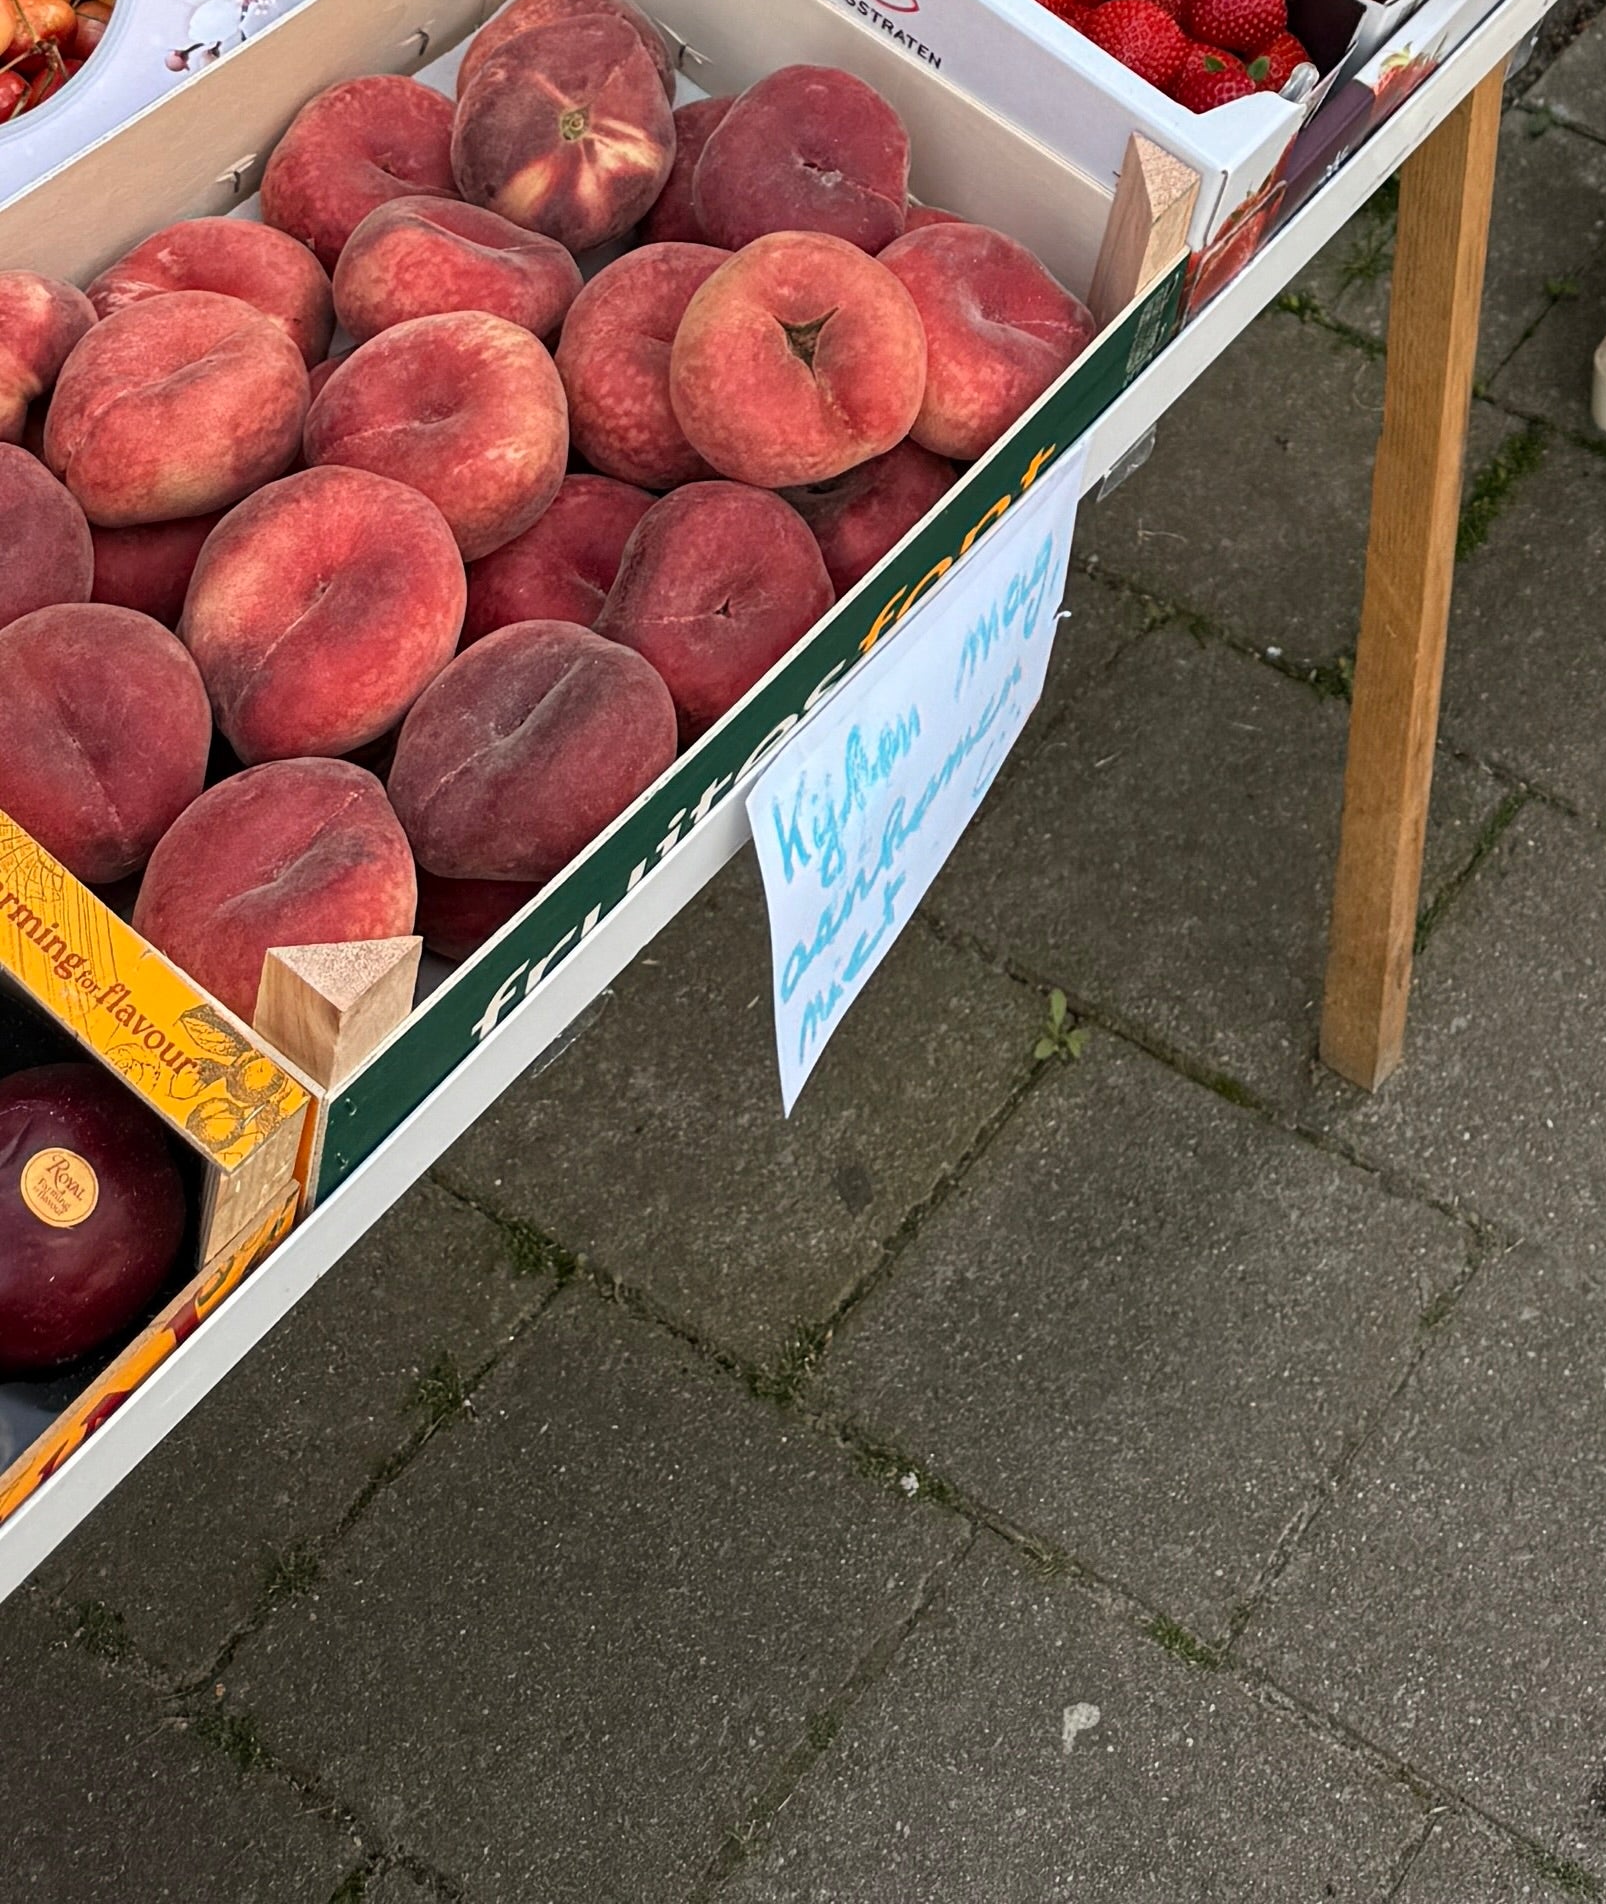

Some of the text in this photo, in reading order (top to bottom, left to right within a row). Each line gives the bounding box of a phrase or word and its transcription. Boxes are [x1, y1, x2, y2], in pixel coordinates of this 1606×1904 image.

[0, 880, 198, 1076] rming for flavour
